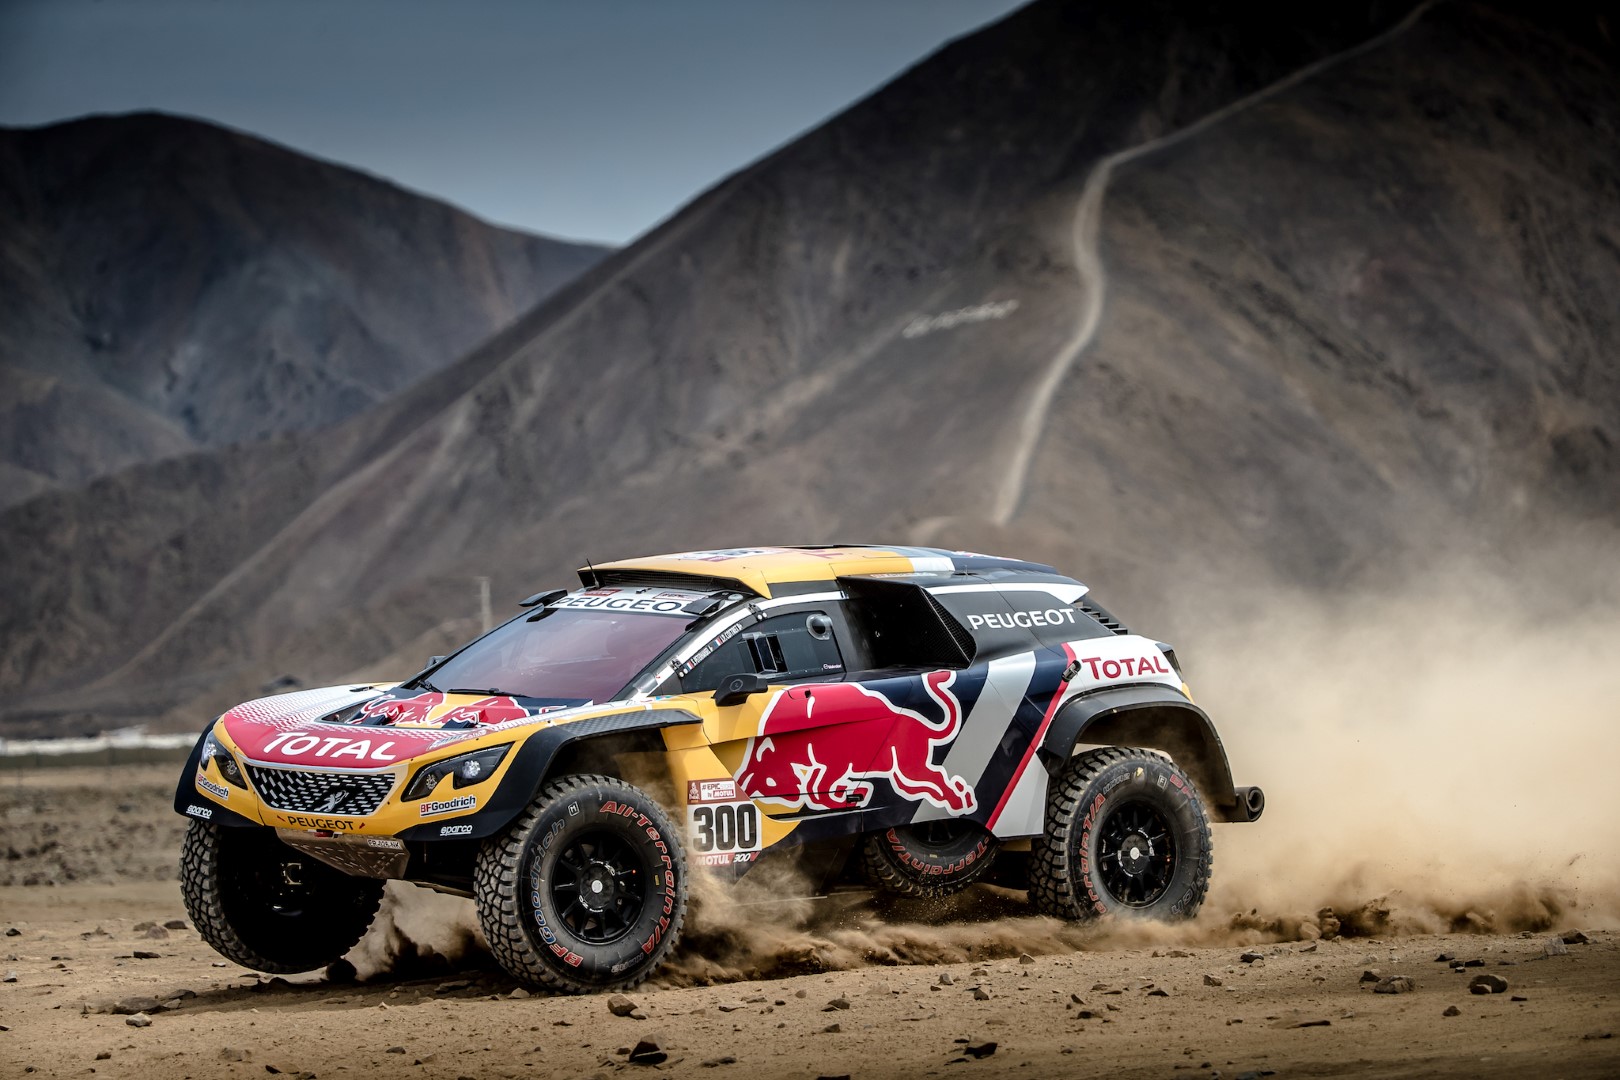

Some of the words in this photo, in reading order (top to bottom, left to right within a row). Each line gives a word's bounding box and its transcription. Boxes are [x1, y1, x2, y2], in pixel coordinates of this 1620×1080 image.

[550, 597, 683, 612] PEUGEO
[967, 608, 1076, 630] PEUGEOT
[1081, 655, 1169, 680] TOTAL
[263, 732, 397, 761] TOTAL
[187, 805, 212, 818] sparco
[420, 795, 476, 813] BFGoodrich
[287, 816, 356, 830] PEUGEOT
[440, 825, 473, 836] sparco
[693, 804, 757, 852] 300
[695, 854, 730, 866] MOTUL
[531, 818, 584, 967] BFGoodrich
